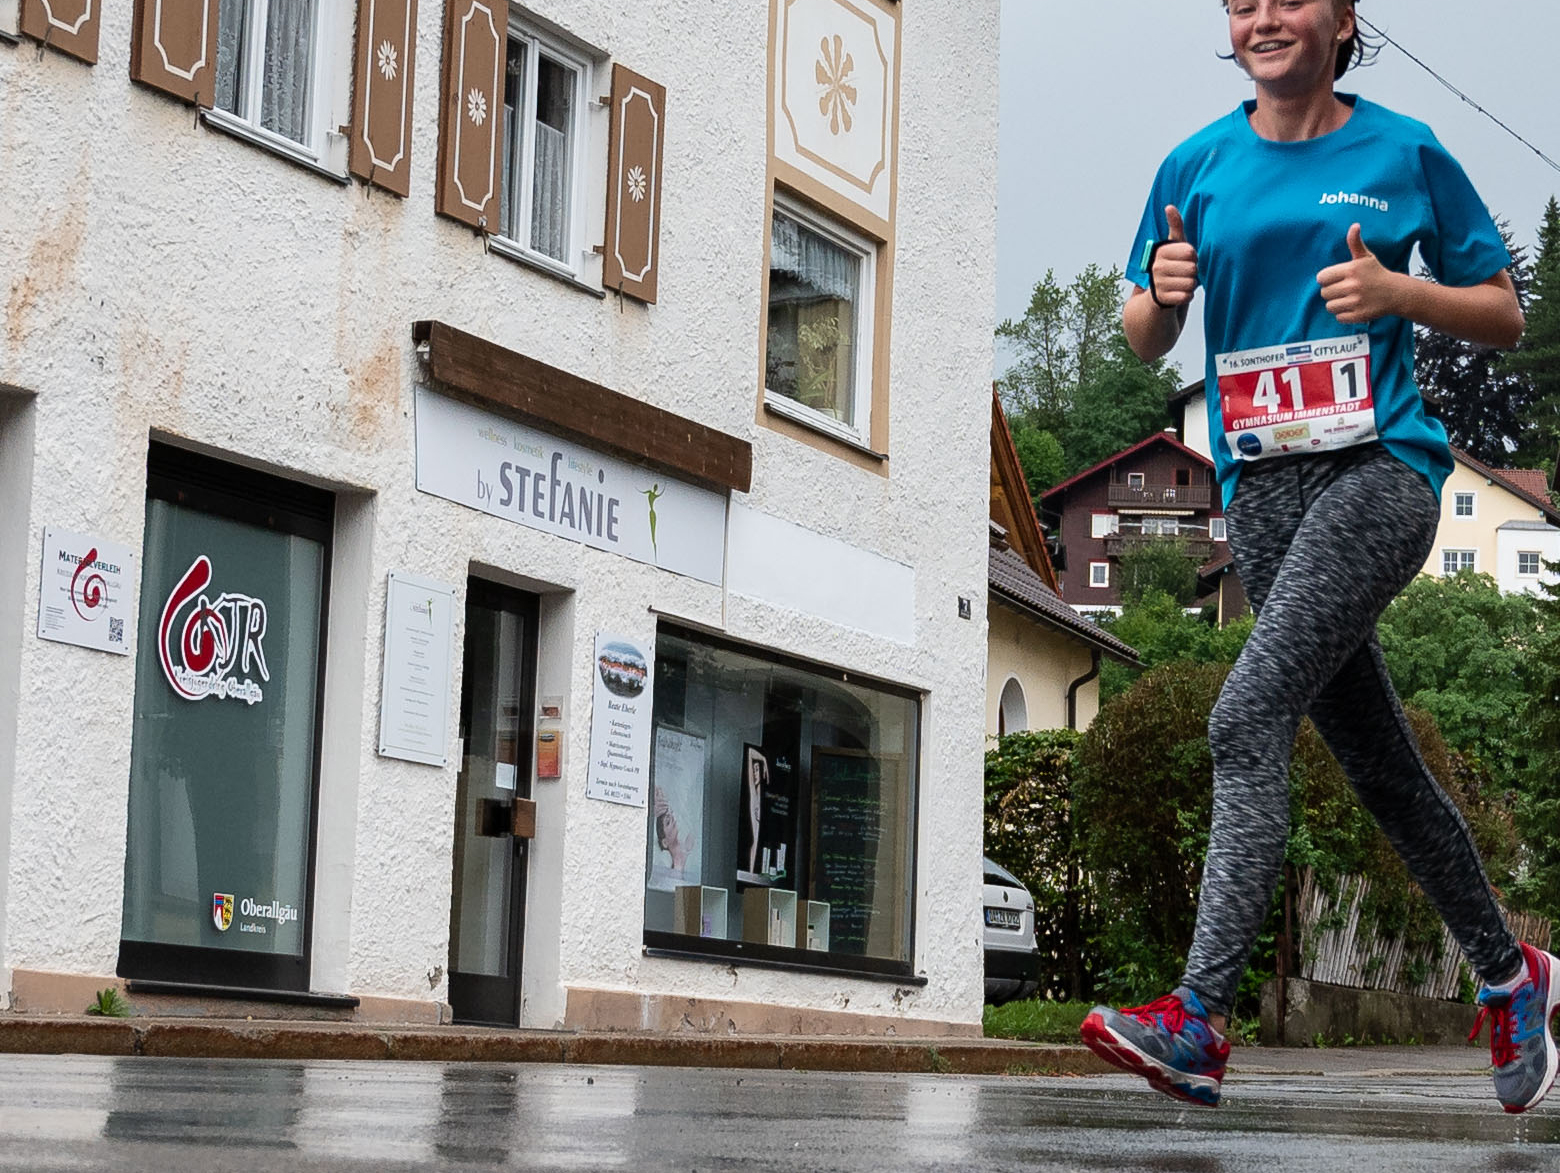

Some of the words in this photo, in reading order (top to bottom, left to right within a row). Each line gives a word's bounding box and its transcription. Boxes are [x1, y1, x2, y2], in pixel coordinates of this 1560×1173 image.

[1319, 191, 1388, 212] Johanna
[1240, 352, 1285, 368] SONTHOFER
[1314, 343, 1358, 357] CITYLAUF
[1252, 367, 1304, 414] 41
[1340, 362, 1357, 399] 1
[1232, 411, 1293, 430] GYMNASIUM
[1294, 402, 1361, 420] IMMENSTADT
[477, 469, 494, 508] by
[59, 550, 121, 574] MATERLVERLEIH
[240, 897, 298, 925] Oberallgäu
[240, 922, 266, 934] Landkreis
